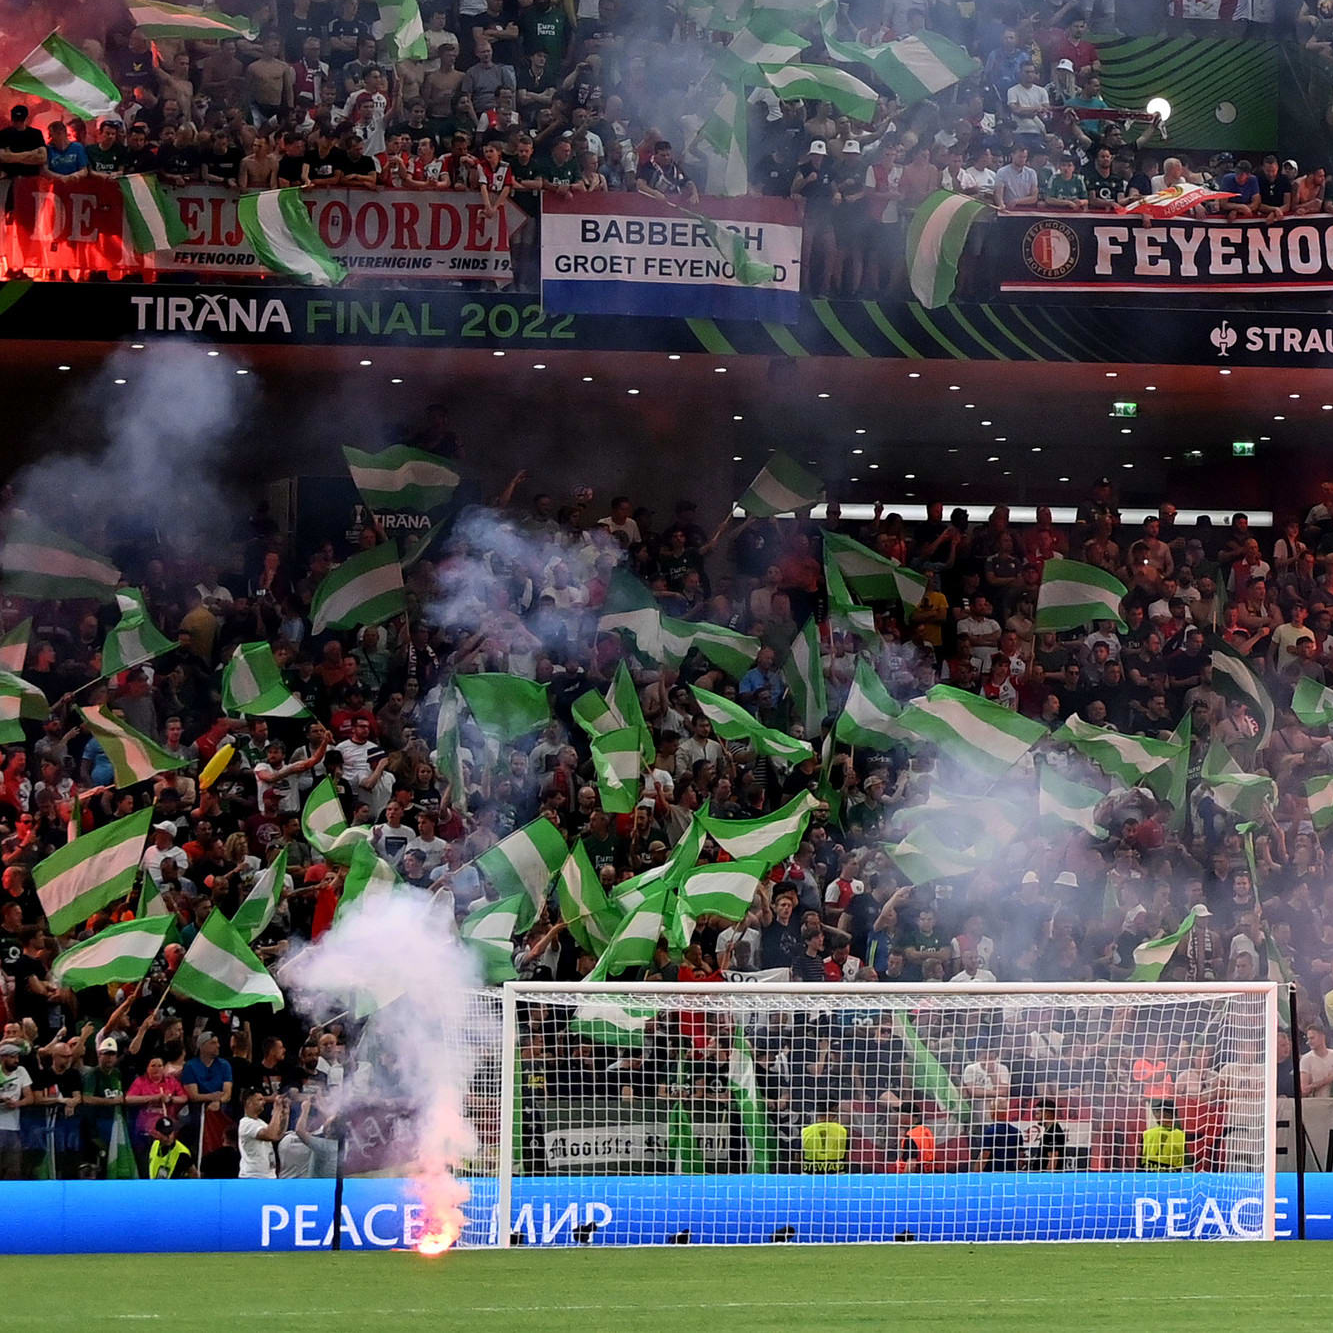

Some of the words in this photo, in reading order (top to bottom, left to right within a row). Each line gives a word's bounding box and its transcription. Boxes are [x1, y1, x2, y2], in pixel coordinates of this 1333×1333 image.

[580, 219, 764, 251] BABBERH
[173, 252, 255, 266] FEYENOORD
[448, 257, 488, 271] SINDS
[554, 254, 636, 274] GROET
[643, 257, 787, 283] FEYENOD
[306, 301, 446, 336] FINAL
[460, 304, 577, 339] 2022
[1134, 1198, 1292, 1238] PEACE
